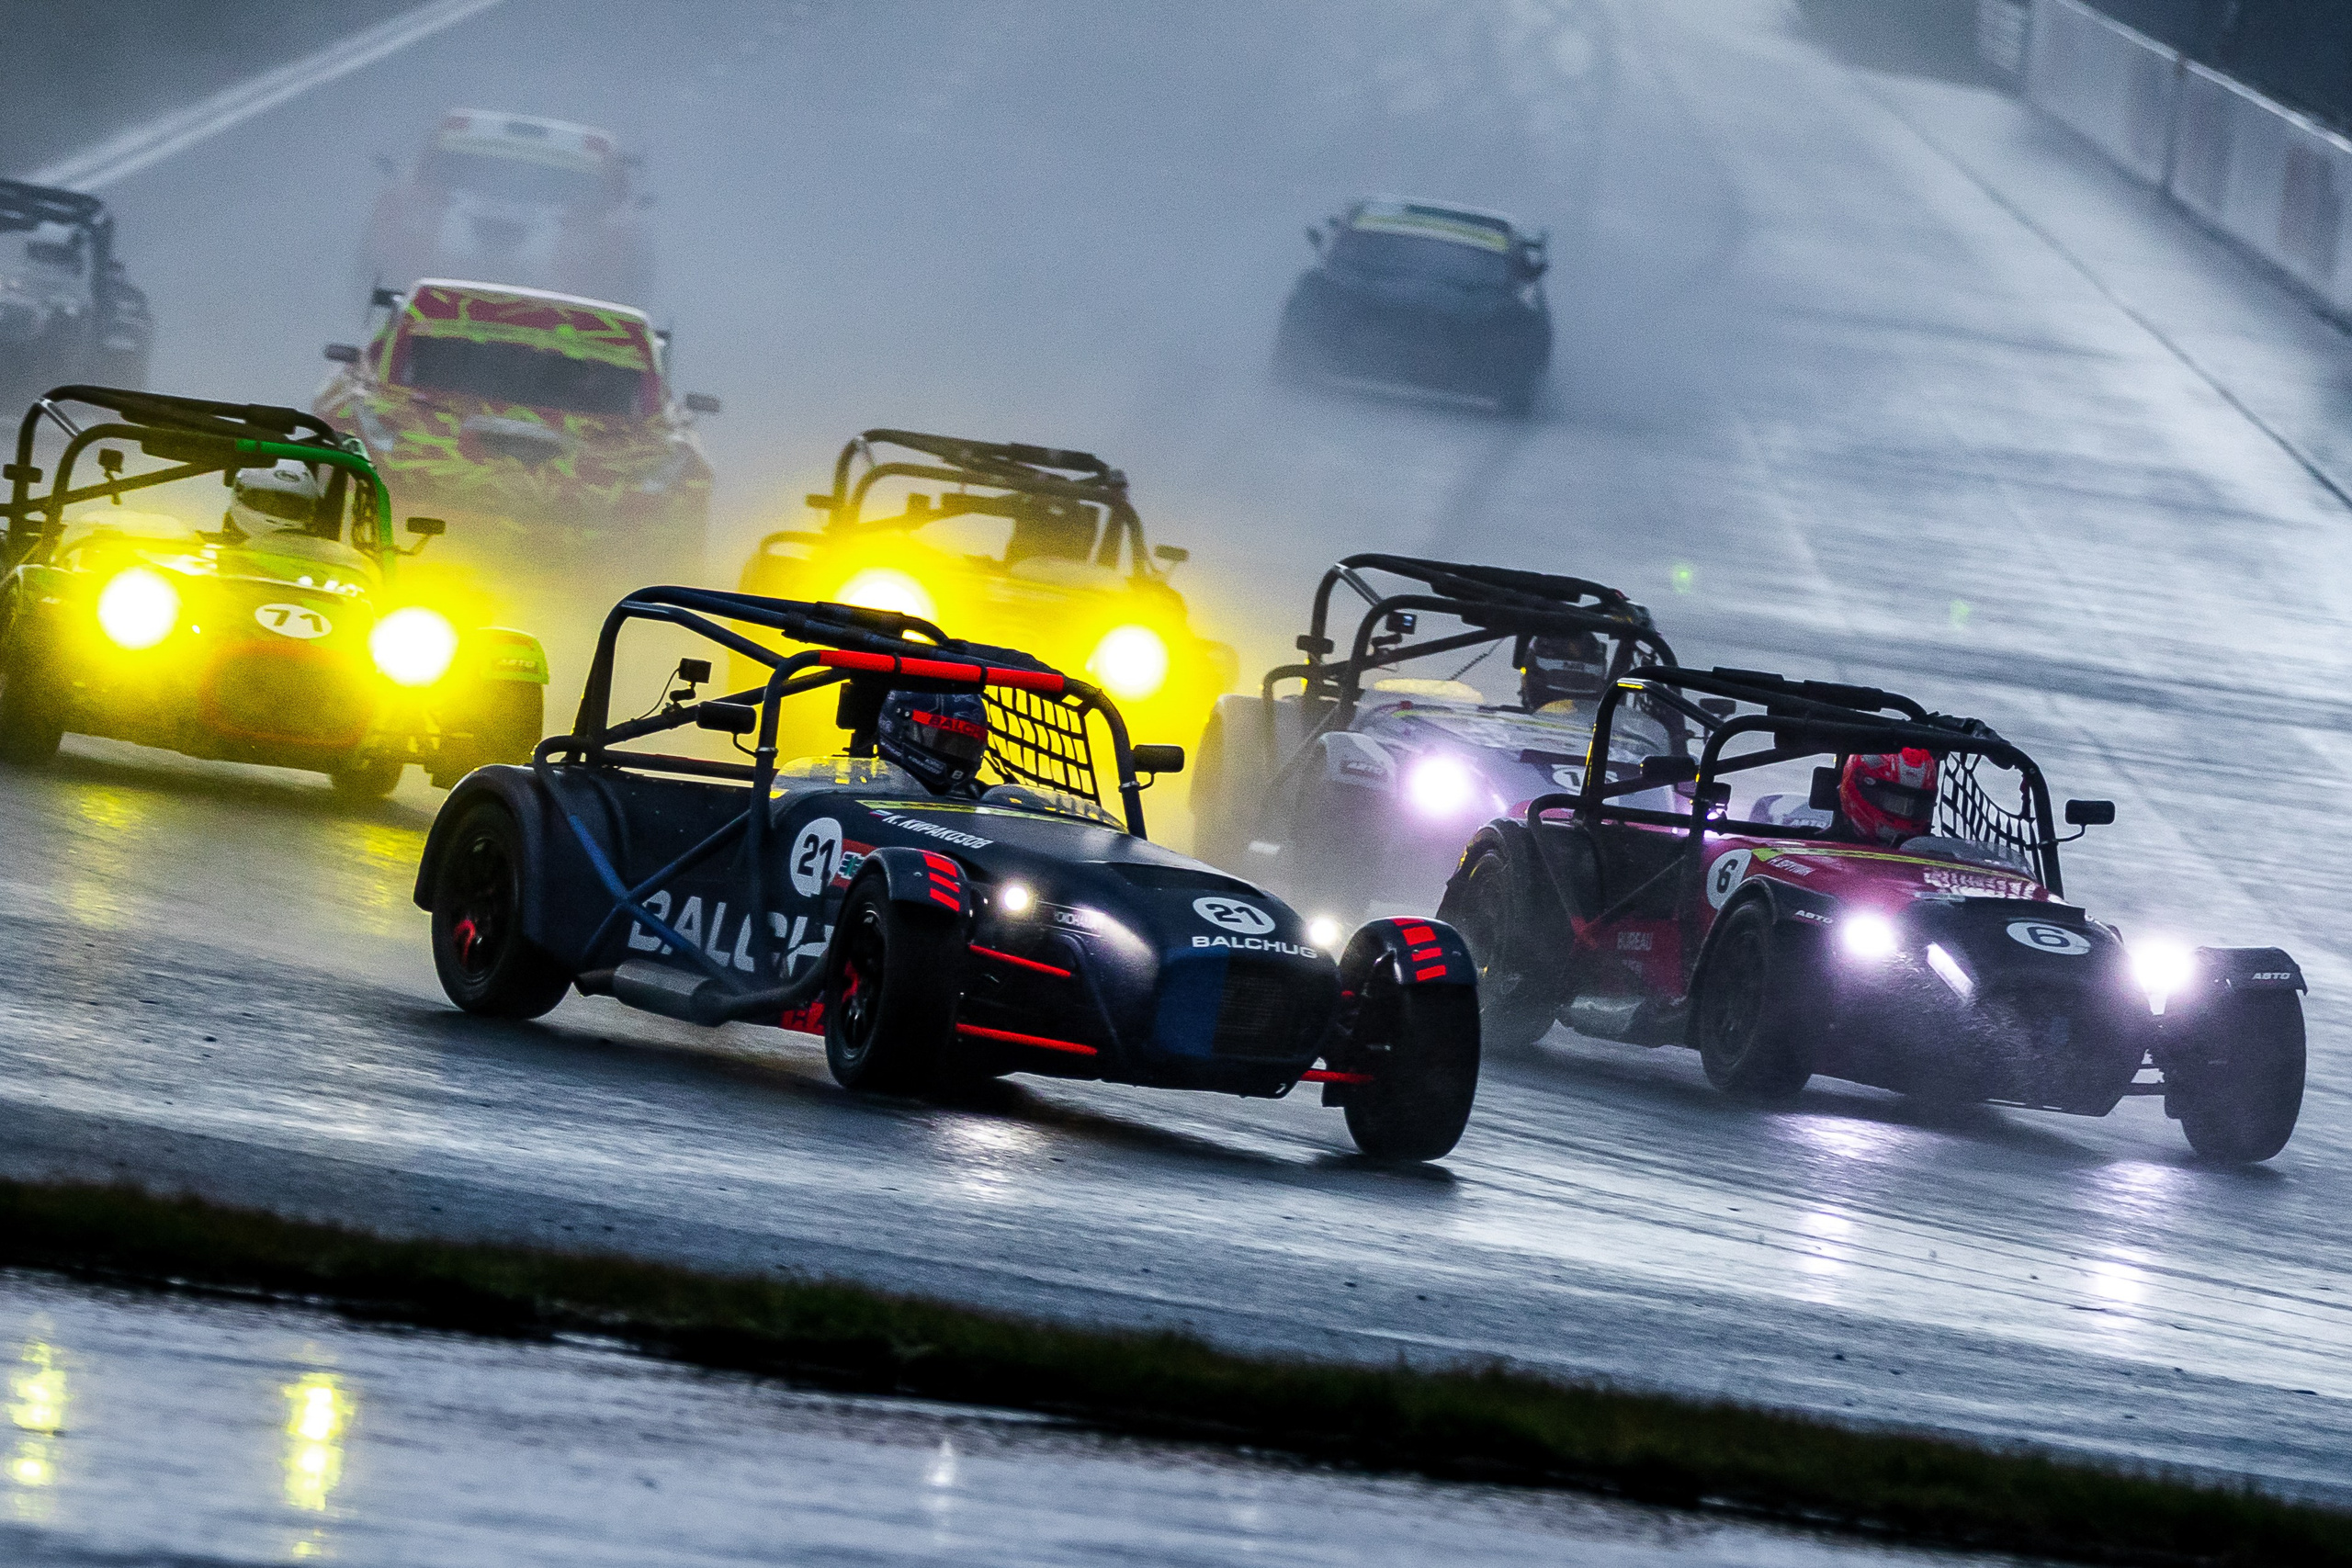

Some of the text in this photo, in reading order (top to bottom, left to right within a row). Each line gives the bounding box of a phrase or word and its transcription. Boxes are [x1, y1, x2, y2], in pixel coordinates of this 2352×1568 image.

[263, 607, 323, 634] 71
[898, 817, 994, 850] КИРАКОЗОВ
[797, 833, 836, 877] 21
[1716, 858, 1739, 894] 6
[1205, 903, 1266, 927] 21
[1192, 935, 1318, 959] BALCHUG
[2027, 926, 2071, 948] 6
